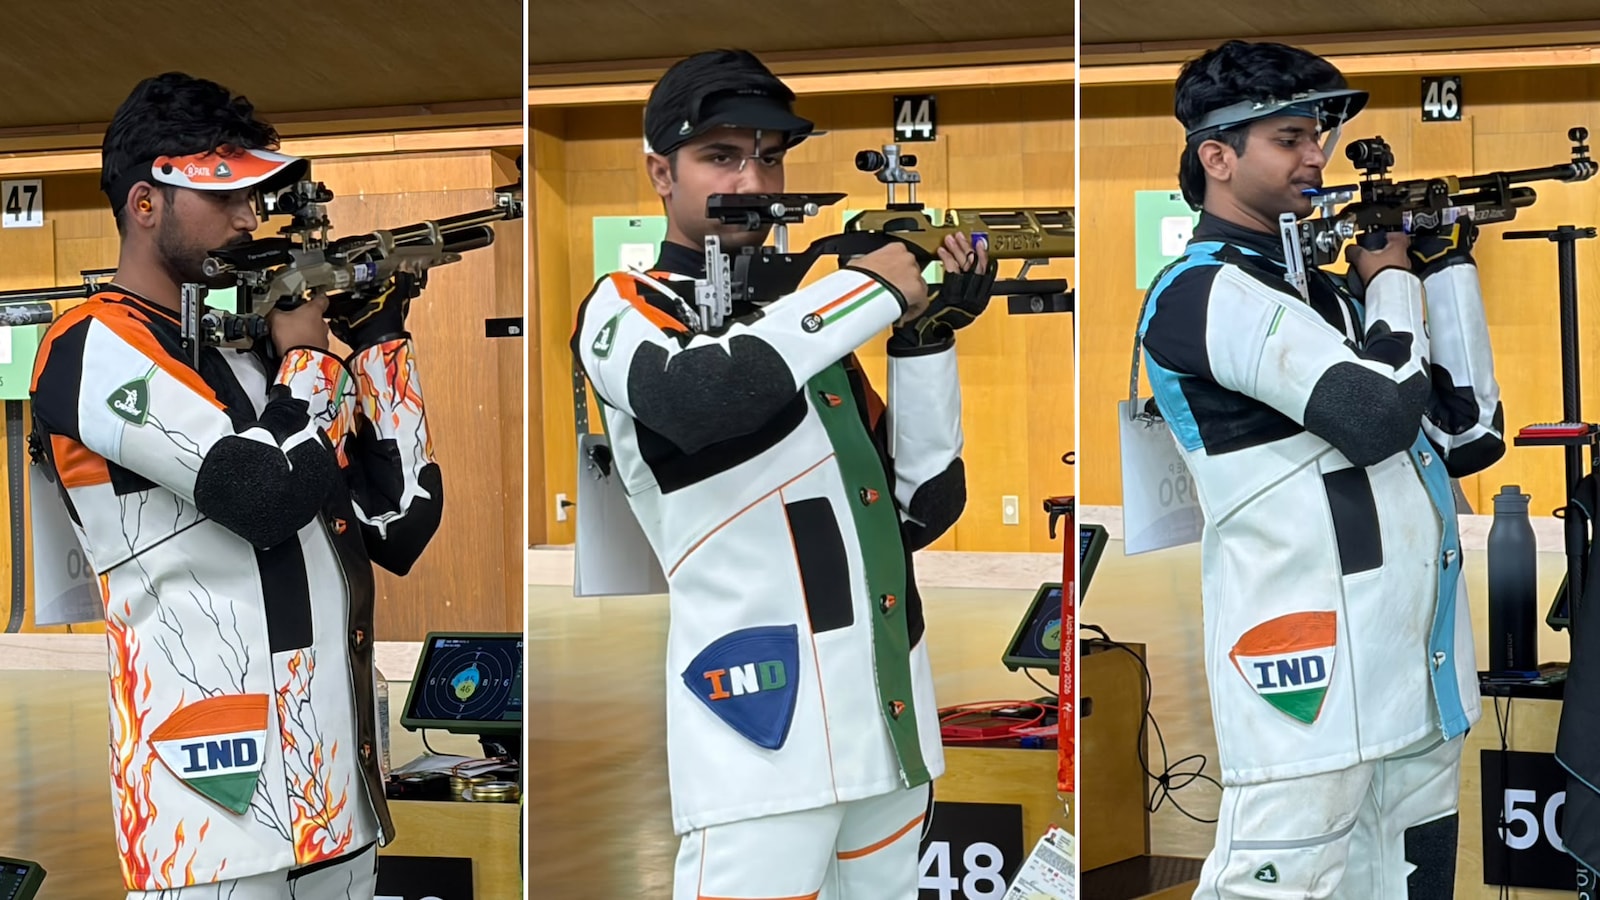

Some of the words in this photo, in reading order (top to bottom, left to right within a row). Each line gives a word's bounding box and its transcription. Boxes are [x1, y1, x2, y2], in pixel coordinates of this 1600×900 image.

[1424, 80, 1458, 118] 46
[896, 100, 932, 138] 44
[6, 185, 38, 221] 47
[994, 234, 1041, 250] STEYR
[703, 660, 787, 701] IND
[1063, 673, 1073, 695] 2026
[1253, 655, 1326, 689] IND
[181, 737, 258, 773] IND
[918, 841, 1007, 900] 48
